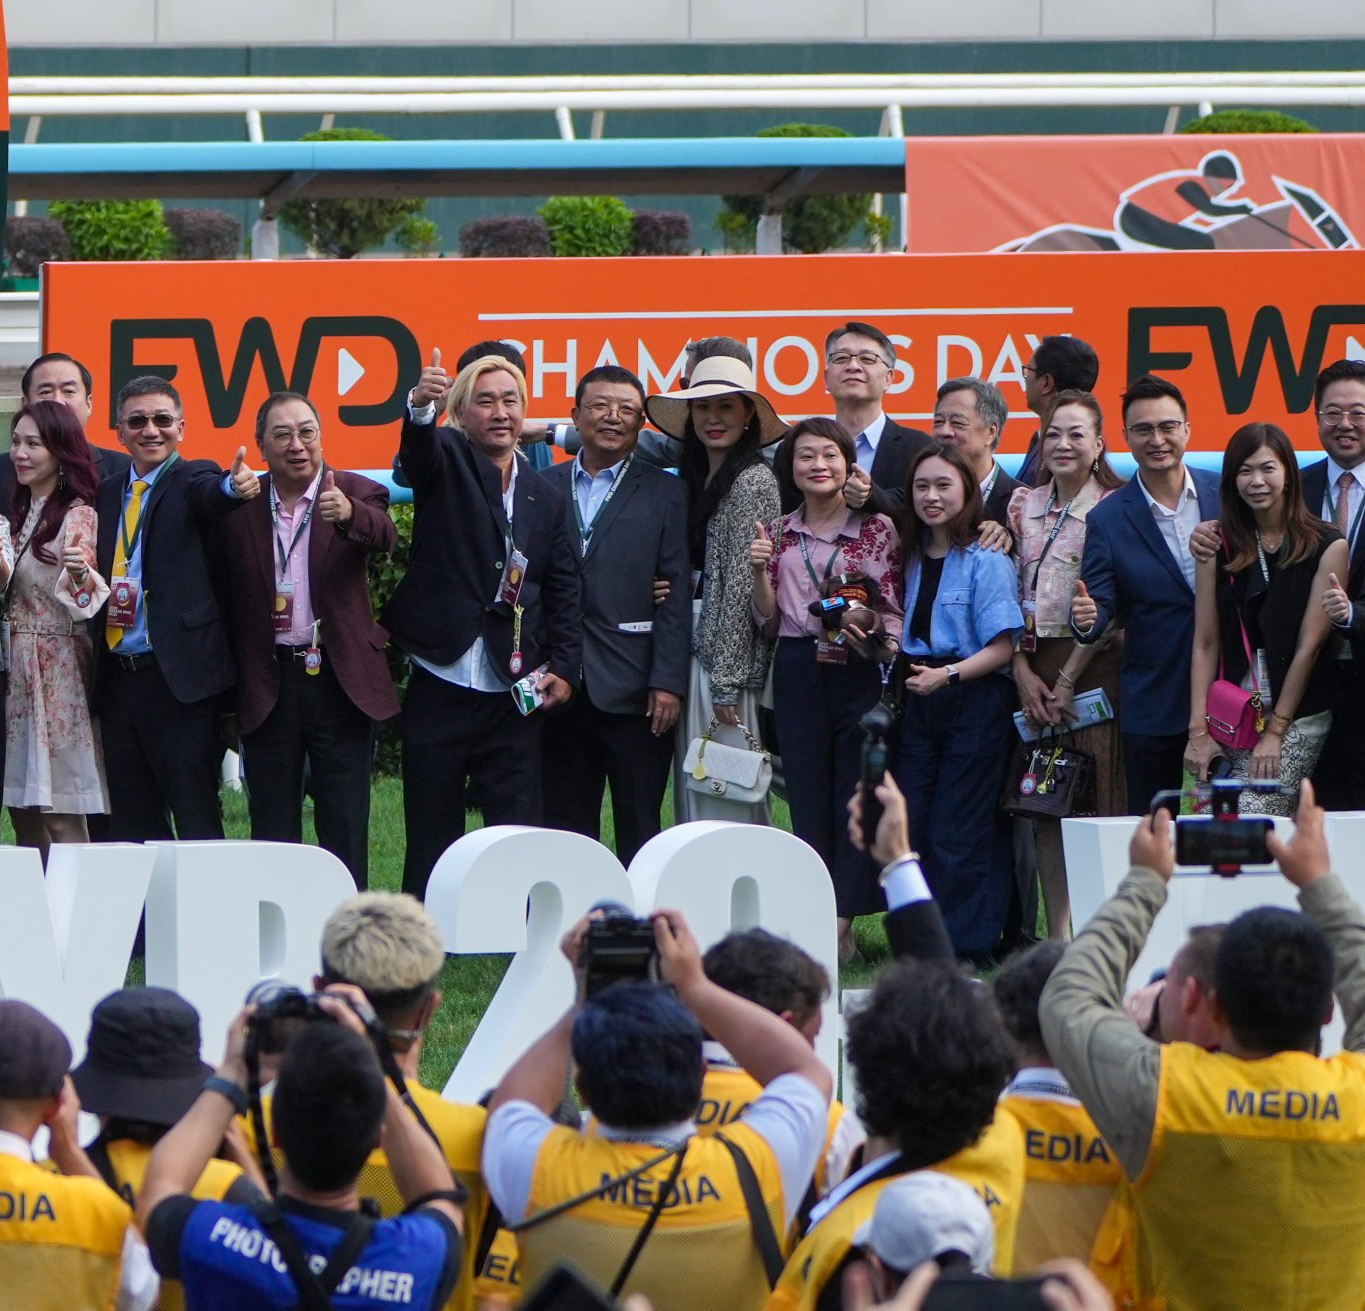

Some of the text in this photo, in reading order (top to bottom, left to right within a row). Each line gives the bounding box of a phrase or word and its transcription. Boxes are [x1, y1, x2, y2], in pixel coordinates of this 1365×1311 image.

[109, 315, 423, 430] FWD
[1226, 1088, 1341, 1122] MEDIA
[1025, 1129, 1111, 1165] EDIA
